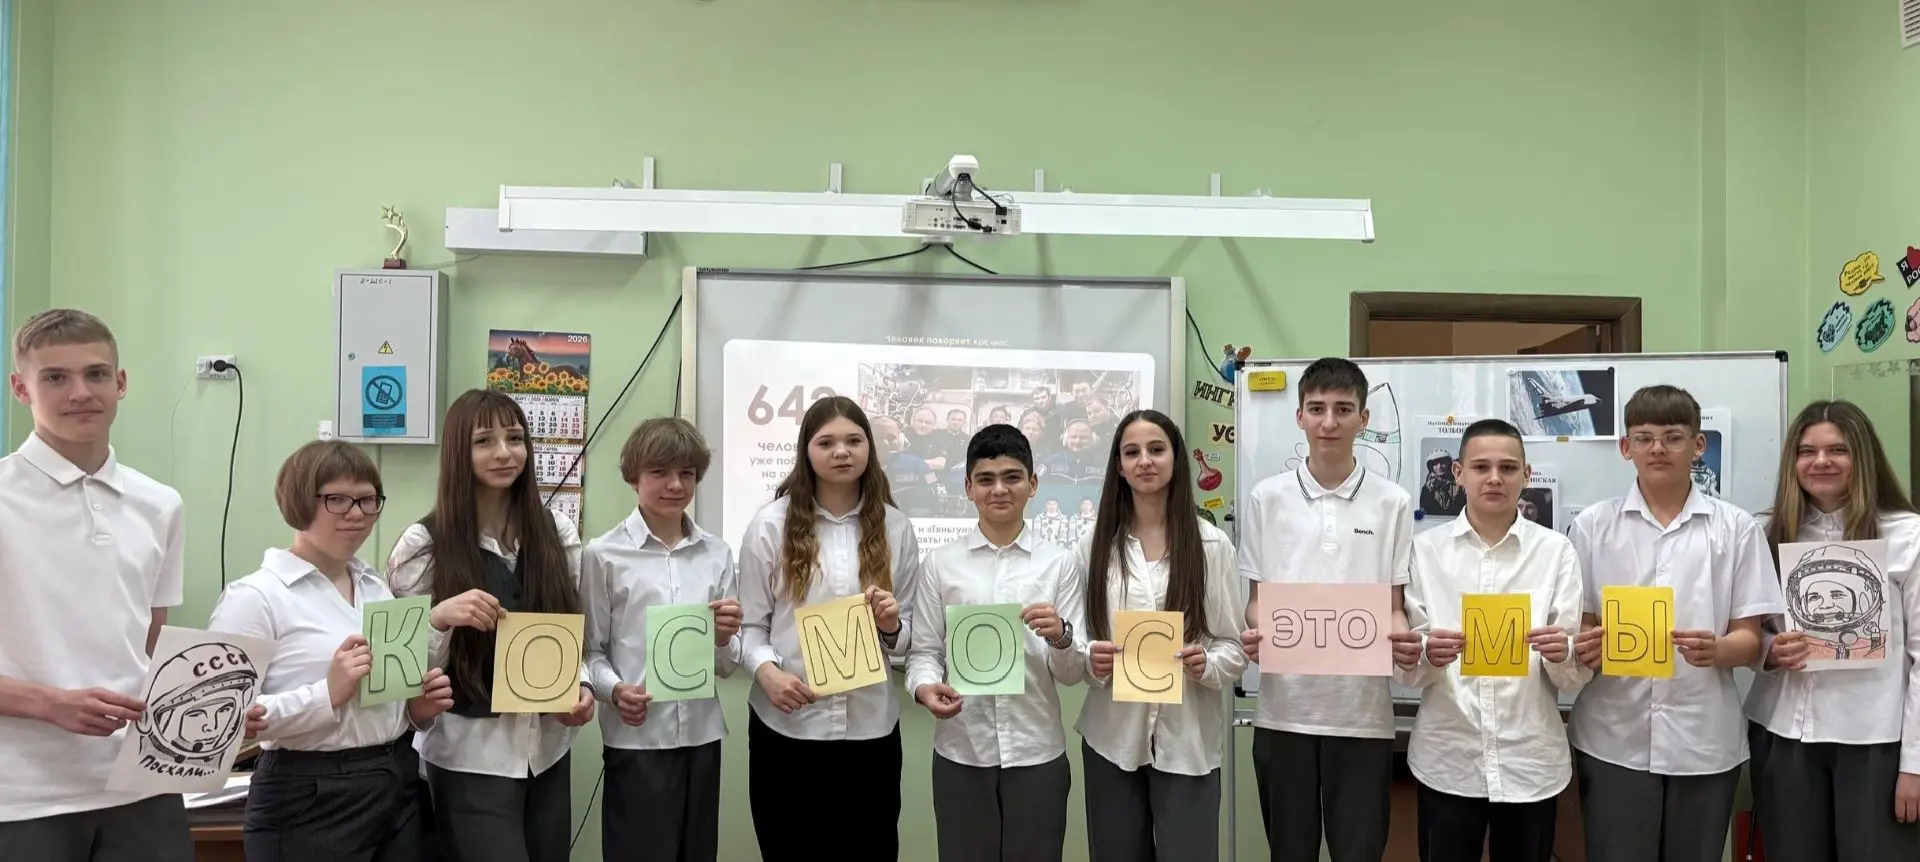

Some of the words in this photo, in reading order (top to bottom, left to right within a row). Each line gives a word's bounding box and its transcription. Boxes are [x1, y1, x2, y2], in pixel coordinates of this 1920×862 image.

[1901, 261, 1909, 271] Я
[567, 335, 588, 343] 2026
[884, 334, 924, 345] Человек
[926, 336, 971, 347] покоряет
[747, 384, 838, 426] 64
[749, 457, 773, 466] уже
[1354, 528, 1375, 536] Bench.
[369, 607, 424, 693] К
[653, 615, 708, 691] С
[803, 603, 880, 686] М
[951, 612, 1017, 685] О
[1122, 620, 1175, 692] С
[1272, 608, 1377, 649] ЭТО
[1463, 607, 1525, 665] М
[1606, 600, 1667, 664] Ы
[505, 623, 580, 702] О
